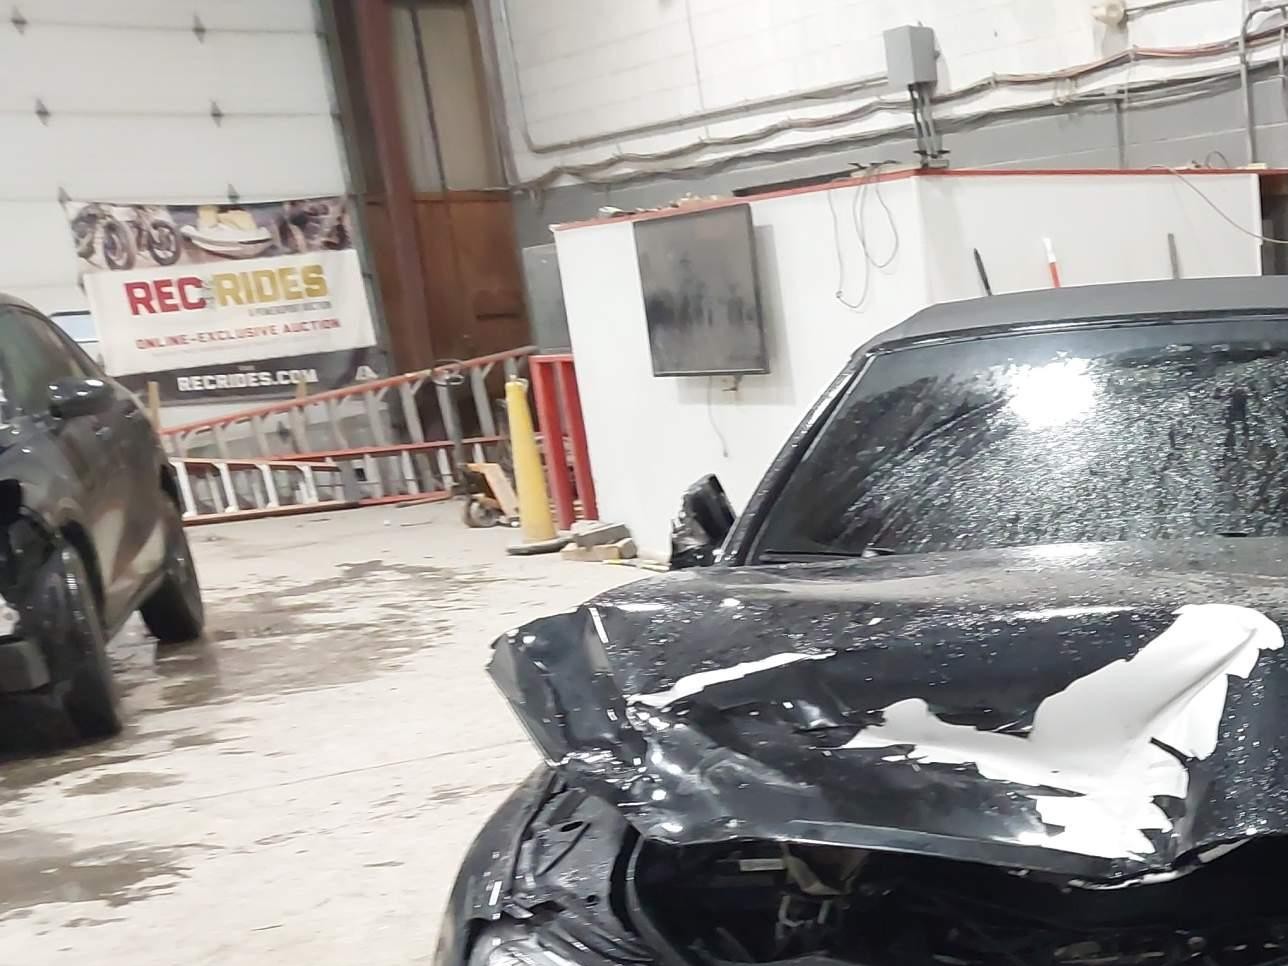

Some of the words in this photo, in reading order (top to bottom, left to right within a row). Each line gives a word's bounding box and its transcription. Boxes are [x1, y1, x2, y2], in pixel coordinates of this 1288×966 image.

[123, 276, 207, 316] REC
[212, 264, 329, 307] RIDES
[135, 324, 279, 350] ONLINE-EXCLUSIVE
[283, 318, 342, 333] AUCTION
[177, 369, 319, 392] RECRIDES.COM
